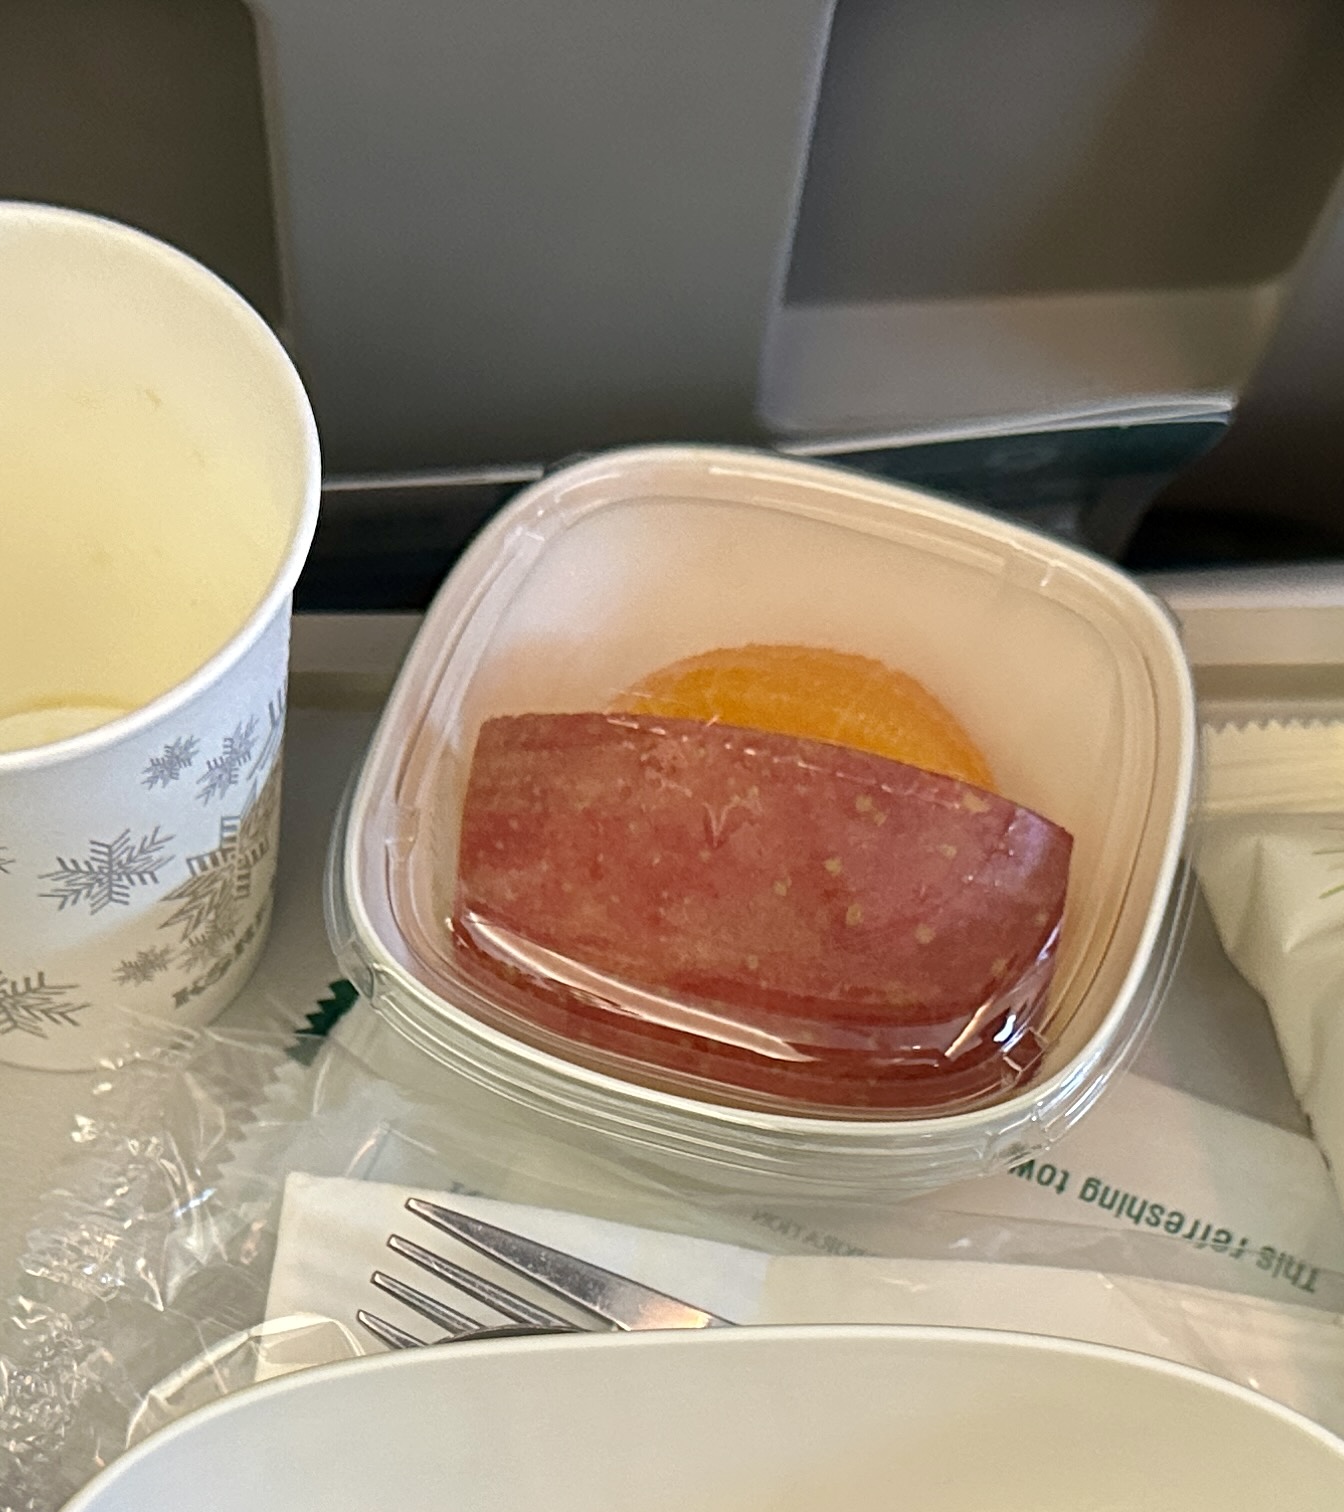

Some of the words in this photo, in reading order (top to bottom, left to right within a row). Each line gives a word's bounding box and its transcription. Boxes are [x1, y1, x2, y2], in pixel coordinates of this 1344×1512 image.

[1009, 1158, 1070, 1195] tow
[1078, 1176, 1249, 1259] refreshing
[1257, 1245, 1319, 1294] This
